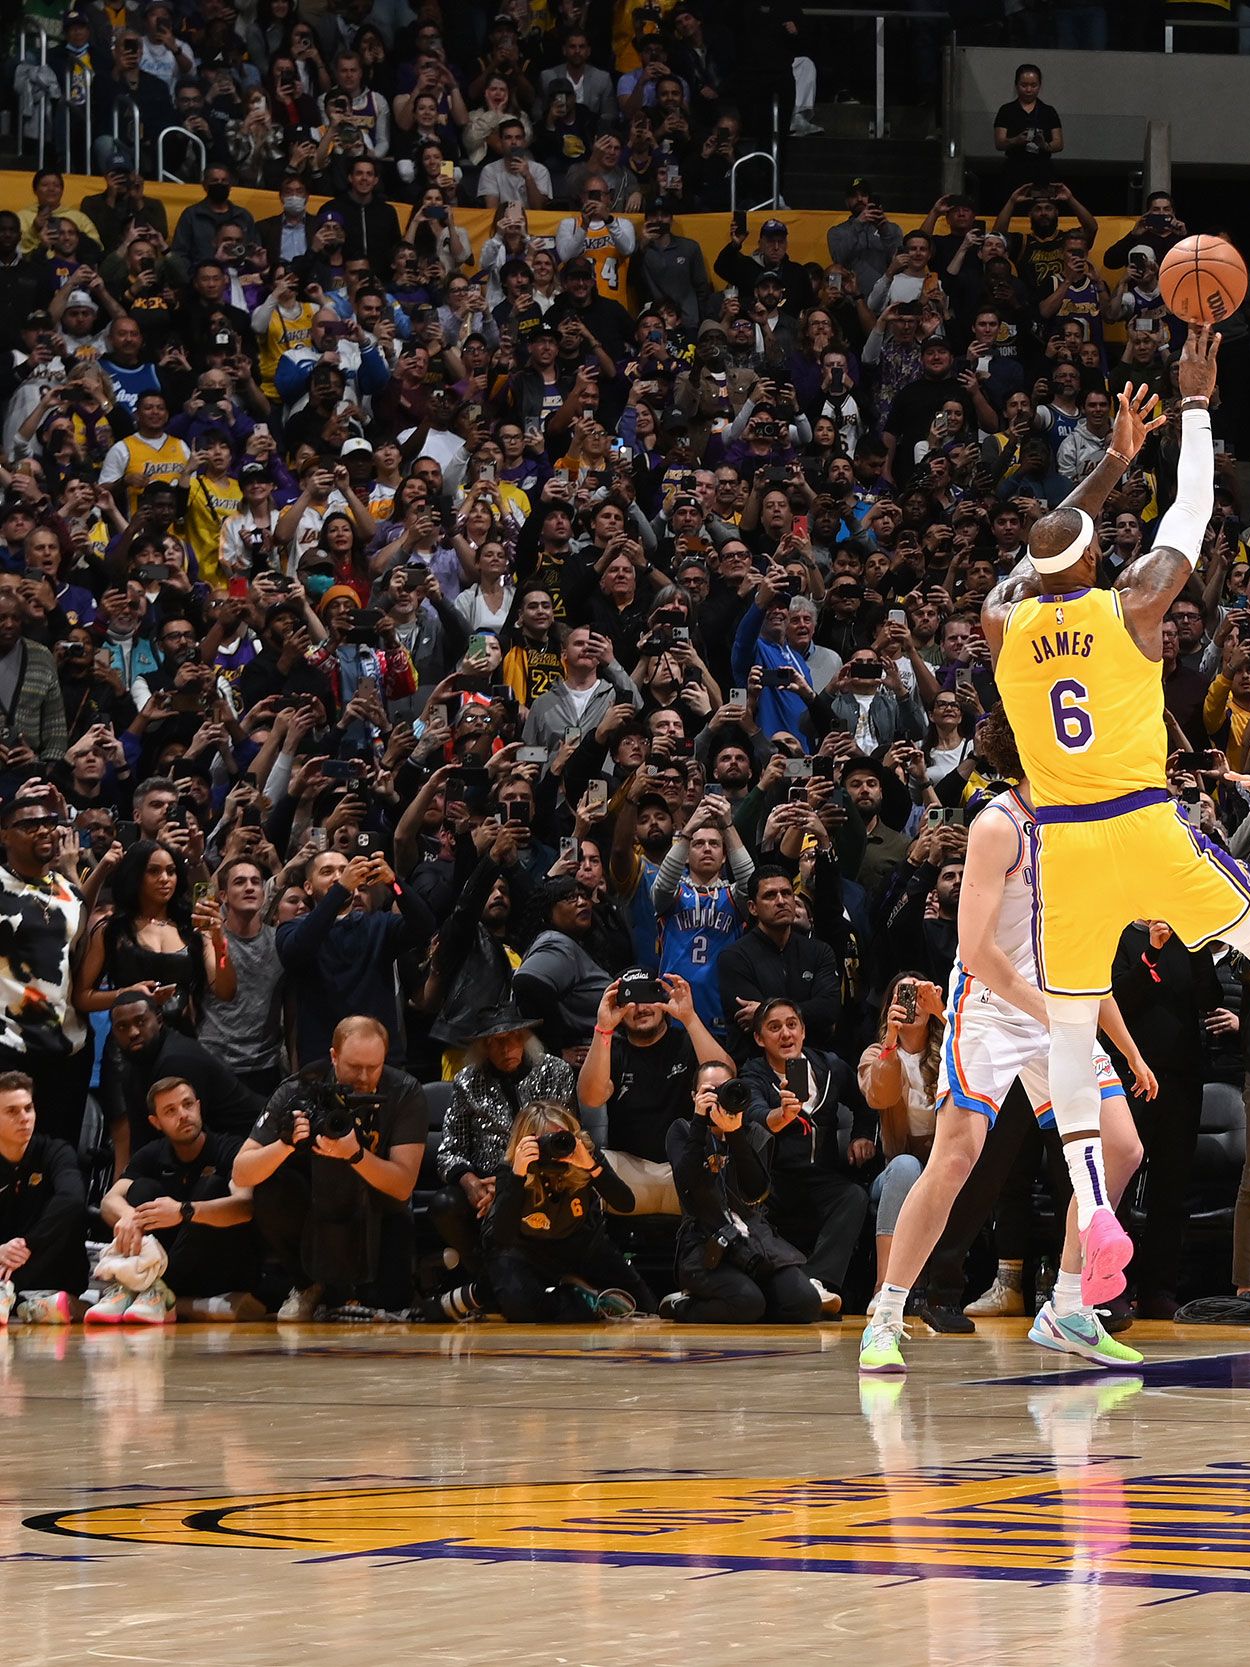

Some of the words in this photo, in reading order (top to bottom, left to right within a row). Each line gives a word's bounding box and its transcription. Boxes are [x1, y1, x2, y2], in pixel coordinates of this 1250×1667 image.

[1031, 631, 1094, 664] JAMES
[1048, 677, 1096, 755] 6
[673, 908, 735, 934] THUNDER
[691, 935, 708, 964] 2
[571, 1198, 584, 1217] 6
